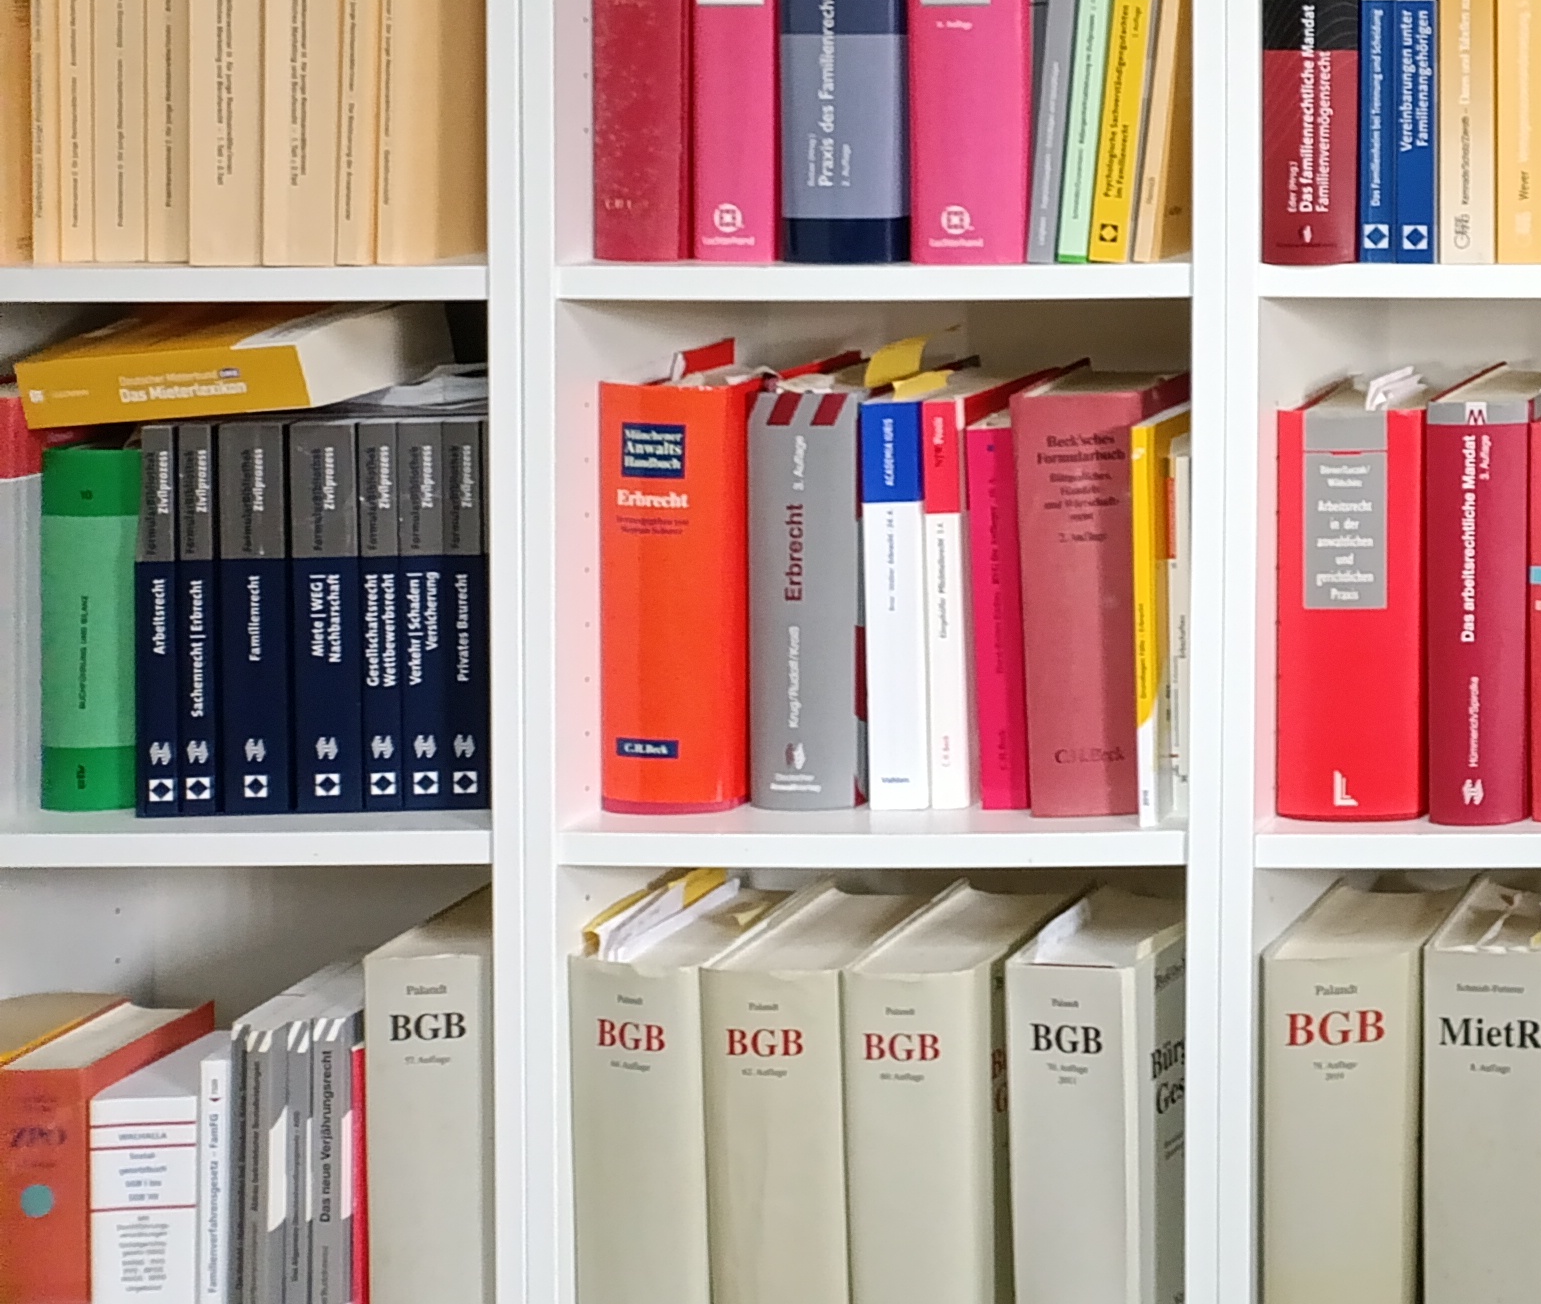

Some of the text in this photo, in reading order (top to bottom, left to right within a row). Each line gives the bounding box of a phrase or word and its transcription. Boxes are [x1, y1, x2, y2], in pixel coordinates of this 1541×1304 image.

[1300, 5, 1316, 212] Das familienrechtliche Mandat
[1400, 9, 1415, 153] Vereinbarungen unter
[1416, 9, 1431, 146] Familienangehörigen
[1316, 51, 1332, 212] Familienvermögensrecht
[119, 380, 247, 403] Das Mieterlexikon
[158, 451, 169, 515] Zivilprozess
[196, 450, 207, 513] Zivilprozess
[617, 489, 688, 511] Erbrecht
[784, 504, 805, 602] Erbrecht
[1461, 434, 1477, 643] Das arbeitsrechtliche Mandat
[153, 578, 166, 655] Arbeitsrecht
[190, 580, 204, 718] Sachenrecht Erbrecht
[249, 575, 260, 662] Familienrecht
[311, 582, 323, 657] Miete WEG
[329, 573, 340, 663] Nachbarschaft
[367, 574, 378, 688] Gesellschaftsrecht
[383, 573, 396, 688] Wettbewerbsrecht
[408, 583, 422, 685] Verkehr Schaden
[427, 572, 439, 650] Versicherung
[458, 573, 469, 681] Privates Baurecht
[390, 1012, 466, 1041] BGB
[597, 1018, 666, 1053] BGB
[727, 1029, 803, 1058] BGB
[864, 1033, 940, 1062] BGB
[1030, 1023, 1103, 1055] BGB
[1286, 1009, 1385, 1048] BGB
[320, 1050, 333, 1223] Das neue Verjährungsrecht
